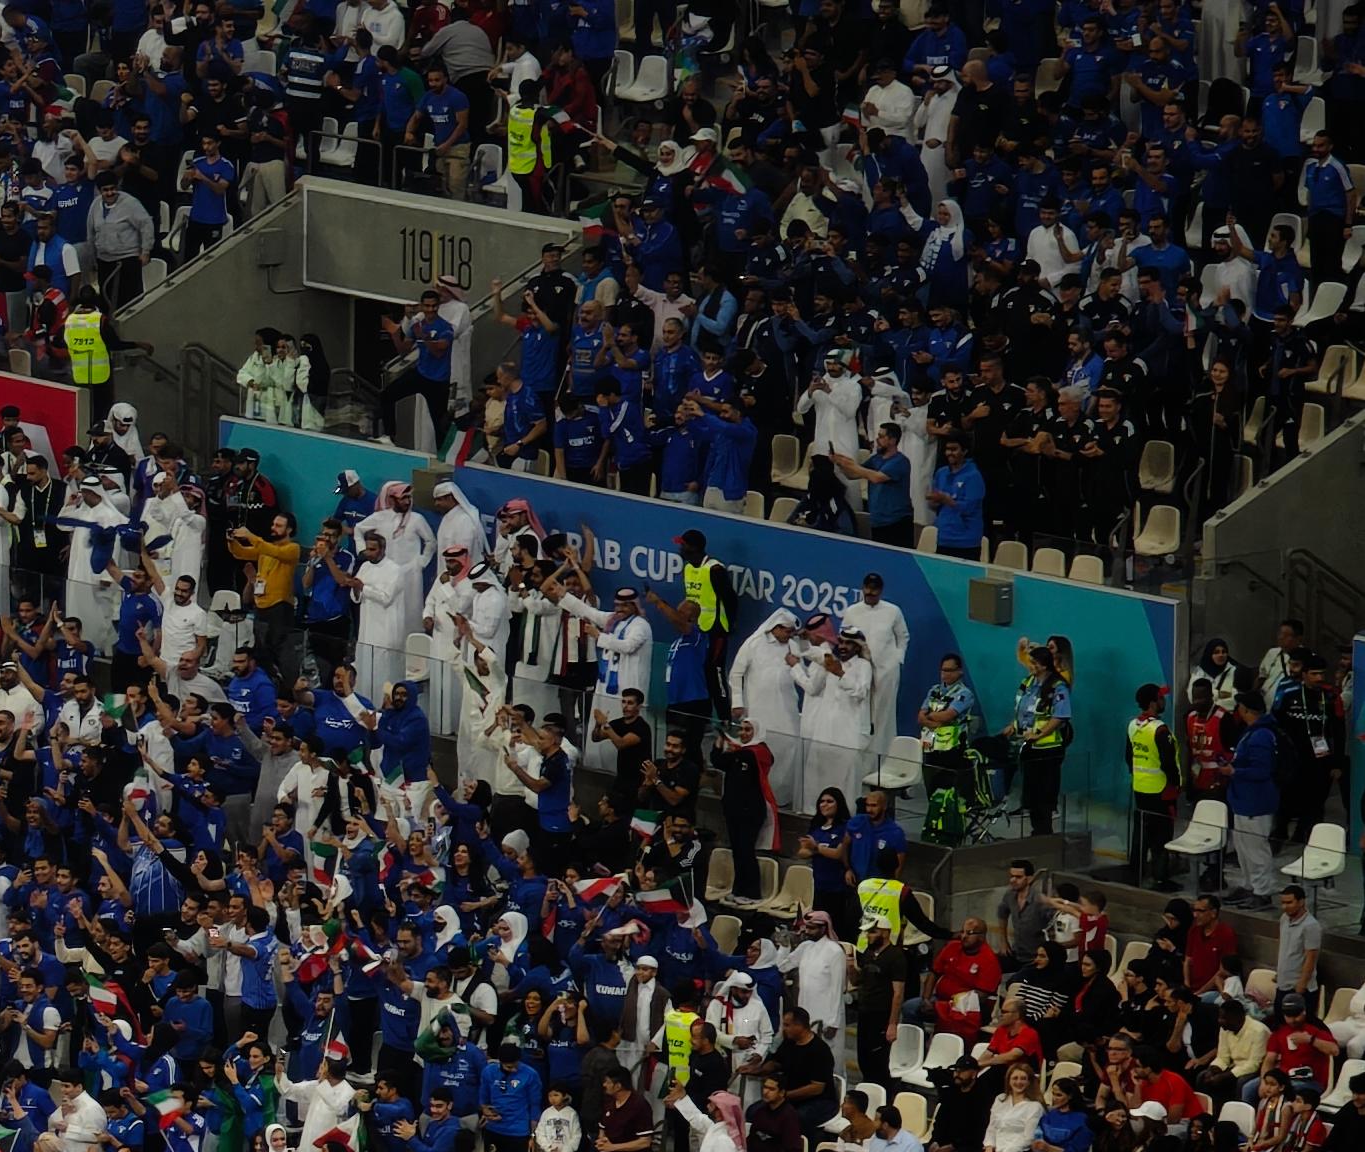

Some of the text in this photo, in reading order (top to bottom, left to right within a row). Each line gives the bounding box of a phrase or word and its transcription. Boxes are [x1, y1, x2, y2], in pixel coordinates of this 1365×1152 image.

[400, 227, 472, 290] 119 118
[630, 545, 683, 583] CUP
[782, 574, 849, 618] 2025
